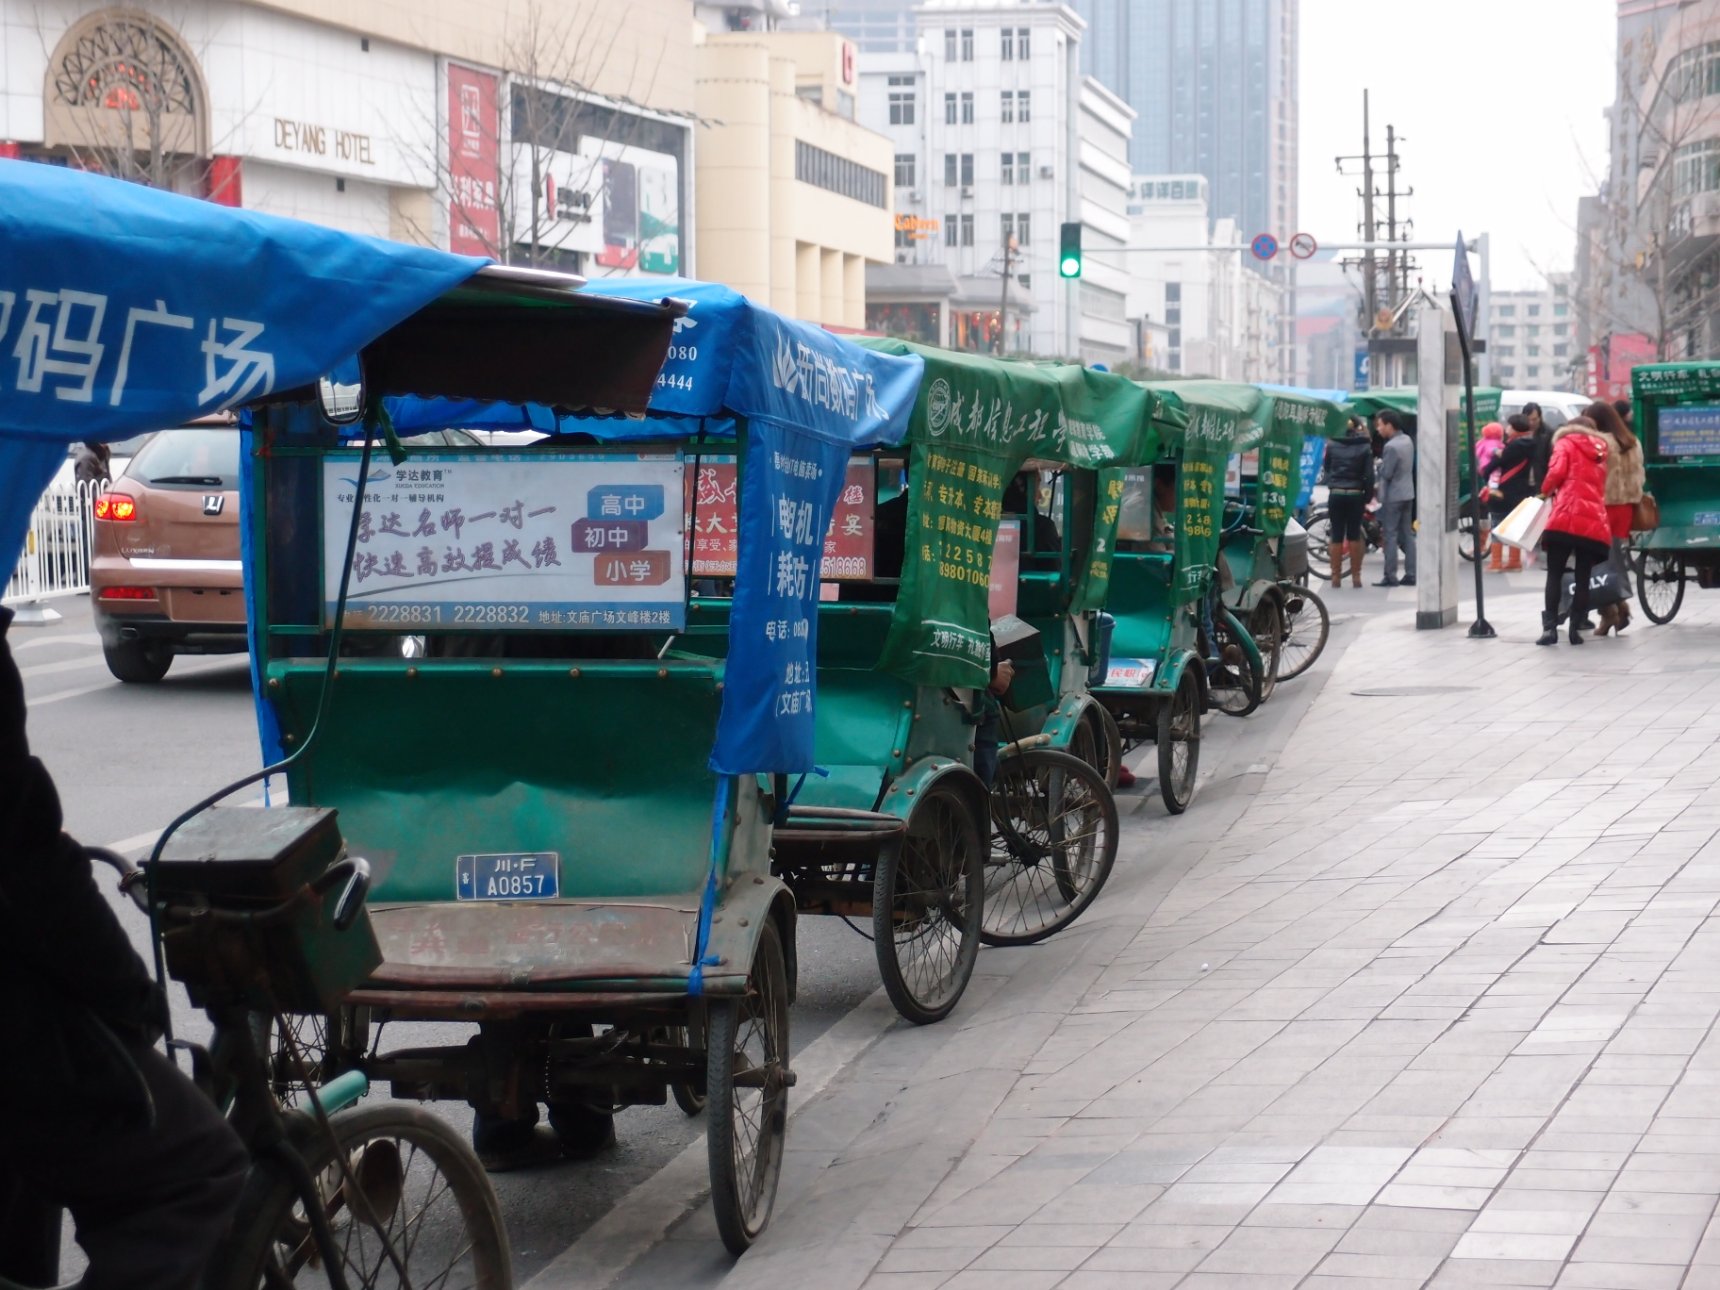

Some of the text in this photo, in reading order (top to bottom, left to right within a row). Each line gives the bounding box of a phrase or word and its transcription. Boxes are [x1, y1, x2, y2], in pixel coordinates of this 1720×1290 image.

[274, 117, 376, 165] DEYANG HOTEL
[395, 469, 443, 482] 学达教育
[336, 493, 445, 503] 专业性化一对一辅导机构
[601, 493, 645, 516] 高中
[584, 526, 629, 549] 初中
[606, 559, 651, 582] 小学
[368, 605, 441, 624] 2228831
[453, 605, 530, 624] 2228832
[487, 874, 545, 896] A0857
